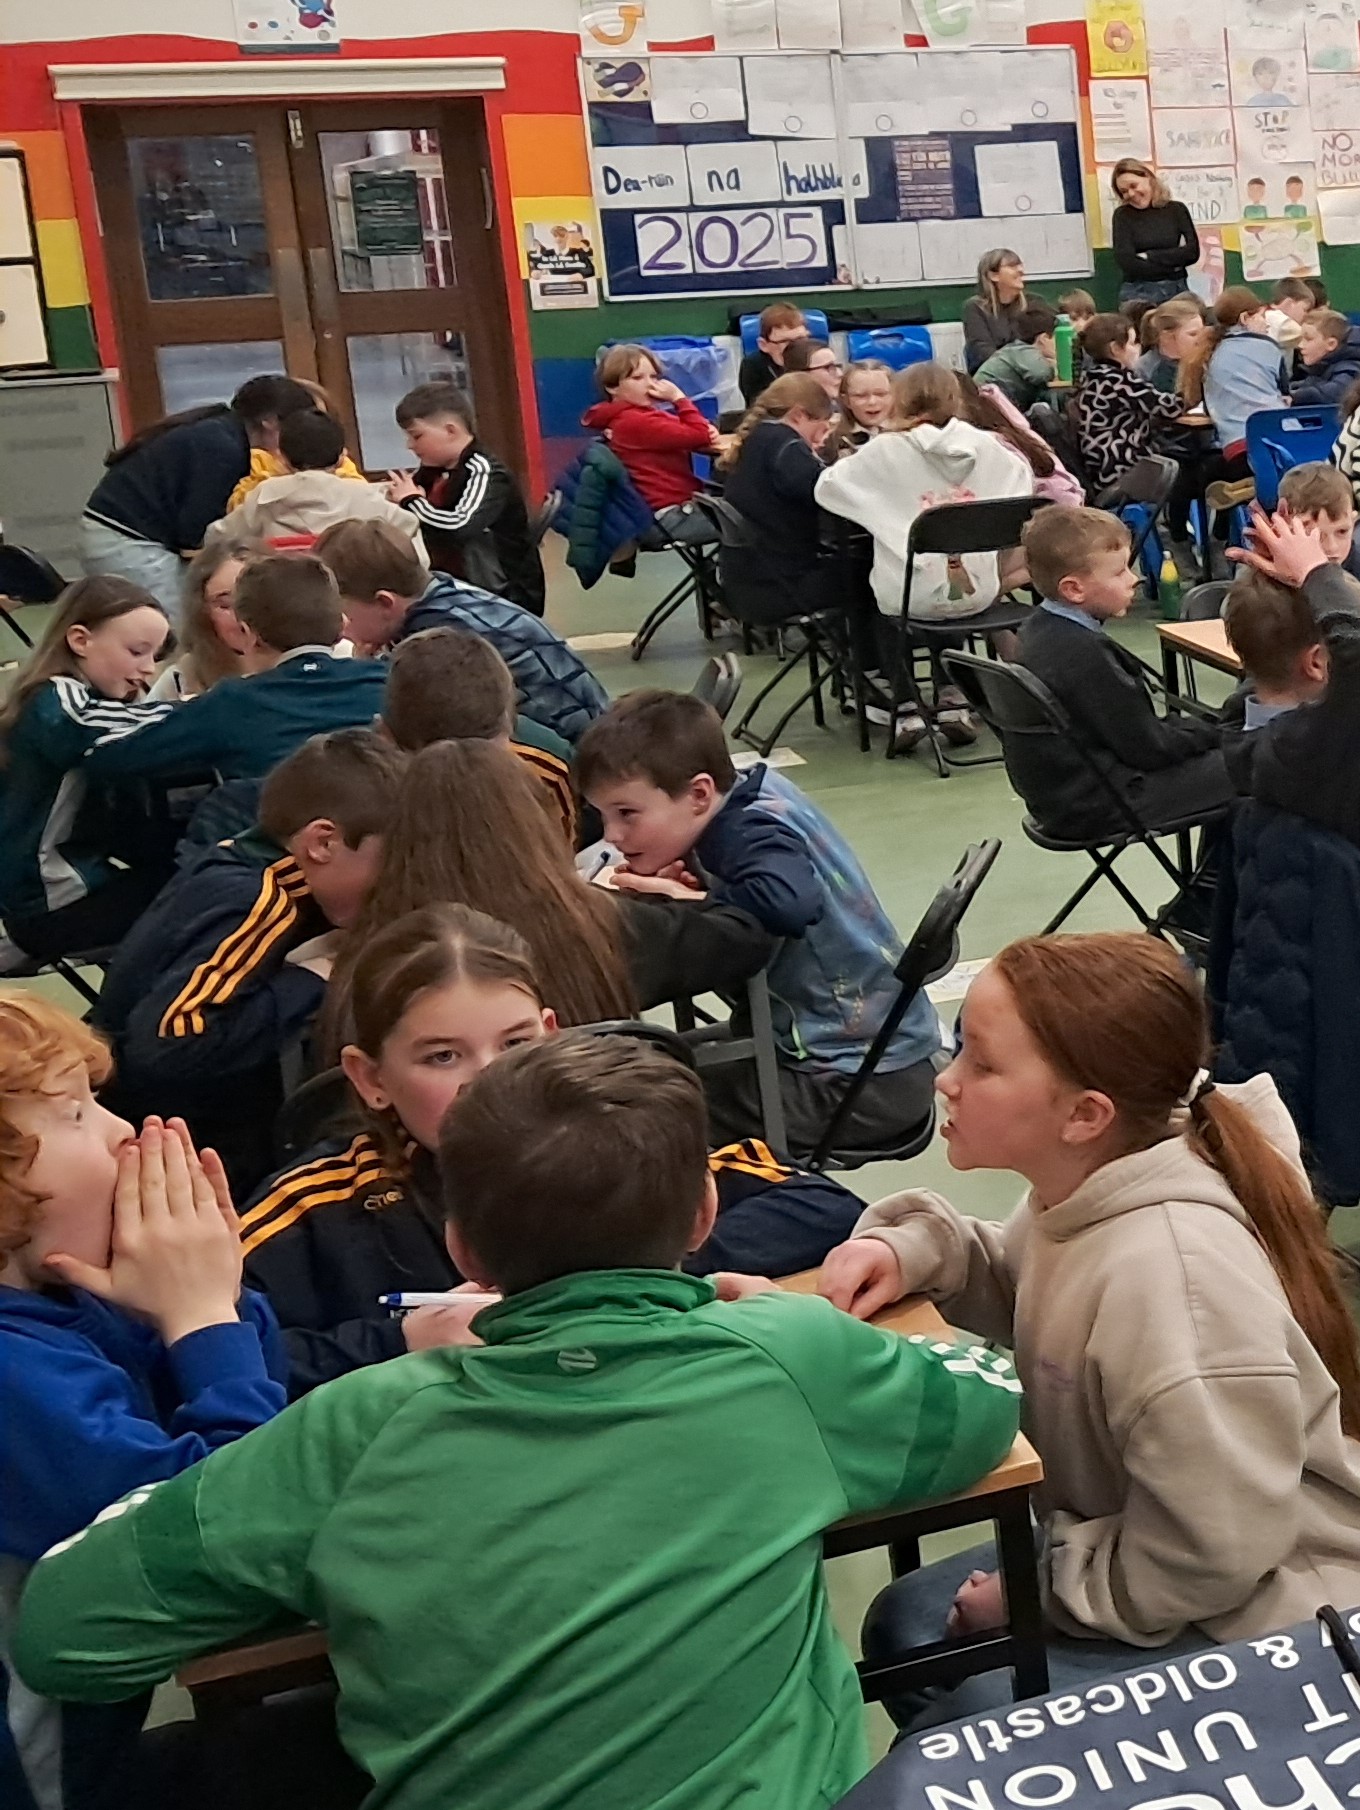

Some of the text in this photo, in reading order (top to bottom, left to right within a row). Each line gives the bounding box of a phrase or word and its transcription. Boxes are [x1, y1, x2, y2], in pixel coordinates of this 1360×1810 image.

[1322, 133, 1353, 152] NO
[707, 168, 740, 192] na
[638, 212, 817, 270] 2025
[1247, 1634, 1301, 1670] &
[918, 1652, 1238, 1762] Oldcastle
